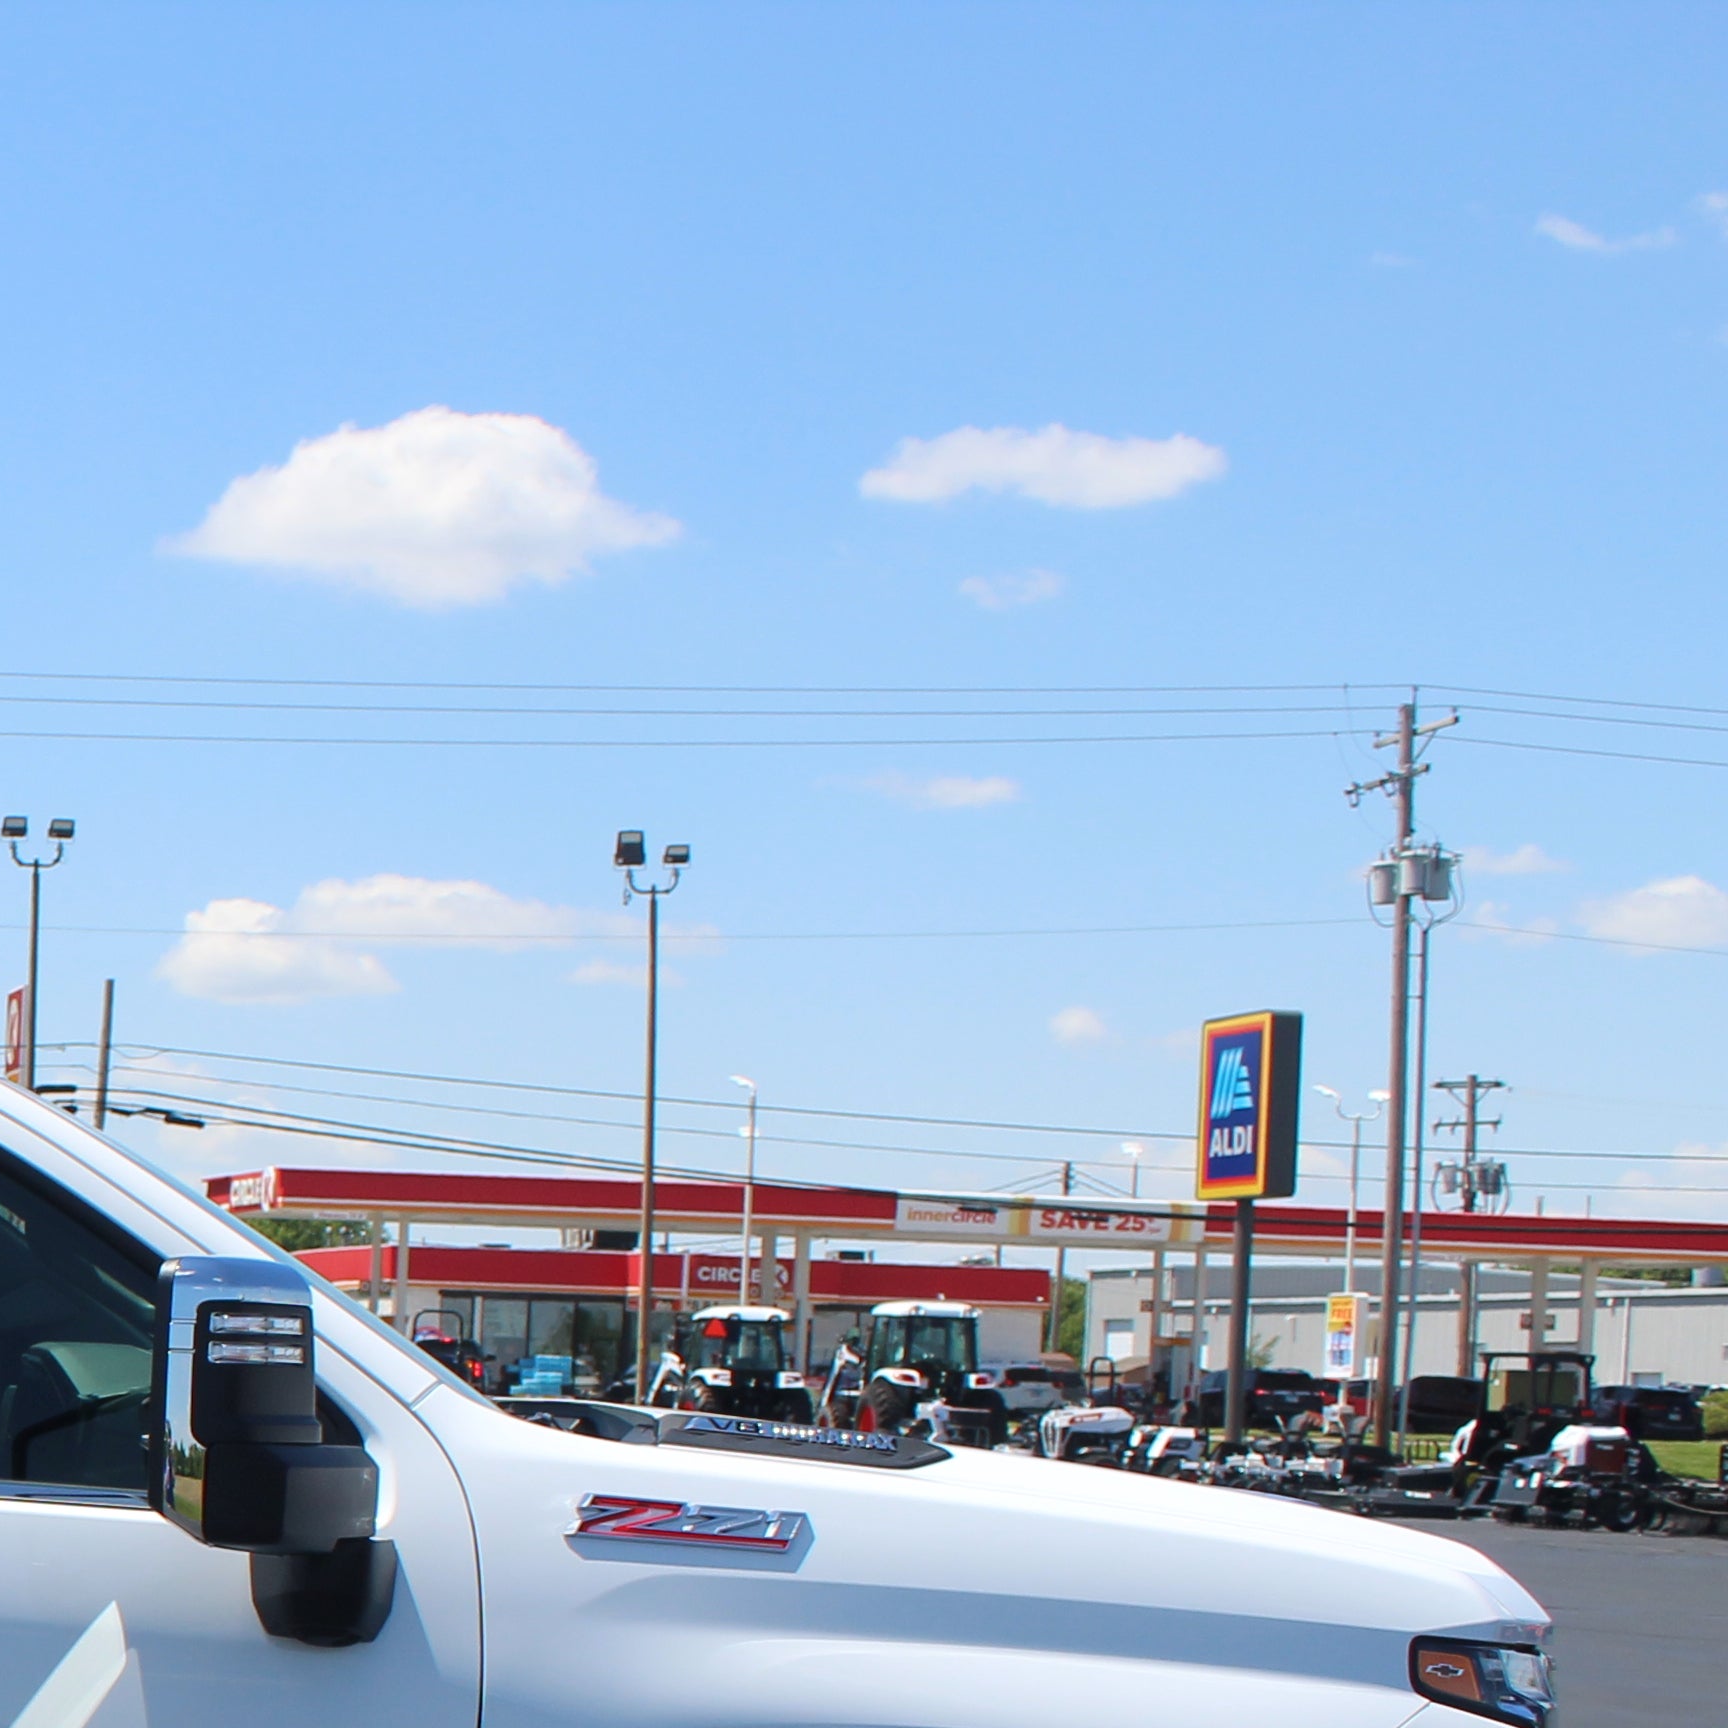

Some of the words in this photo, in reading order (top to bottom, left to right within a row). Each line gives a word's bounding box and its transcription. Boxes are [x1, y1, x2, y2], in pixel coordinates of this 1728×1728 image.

[1208, 1124, 1254, 1158] ALDI
[1040, 1209, 1108, 1231] SAVE
[697, 1265, 762, 1284] CIRCE
[564, 1492, 812, 1554] Z71
